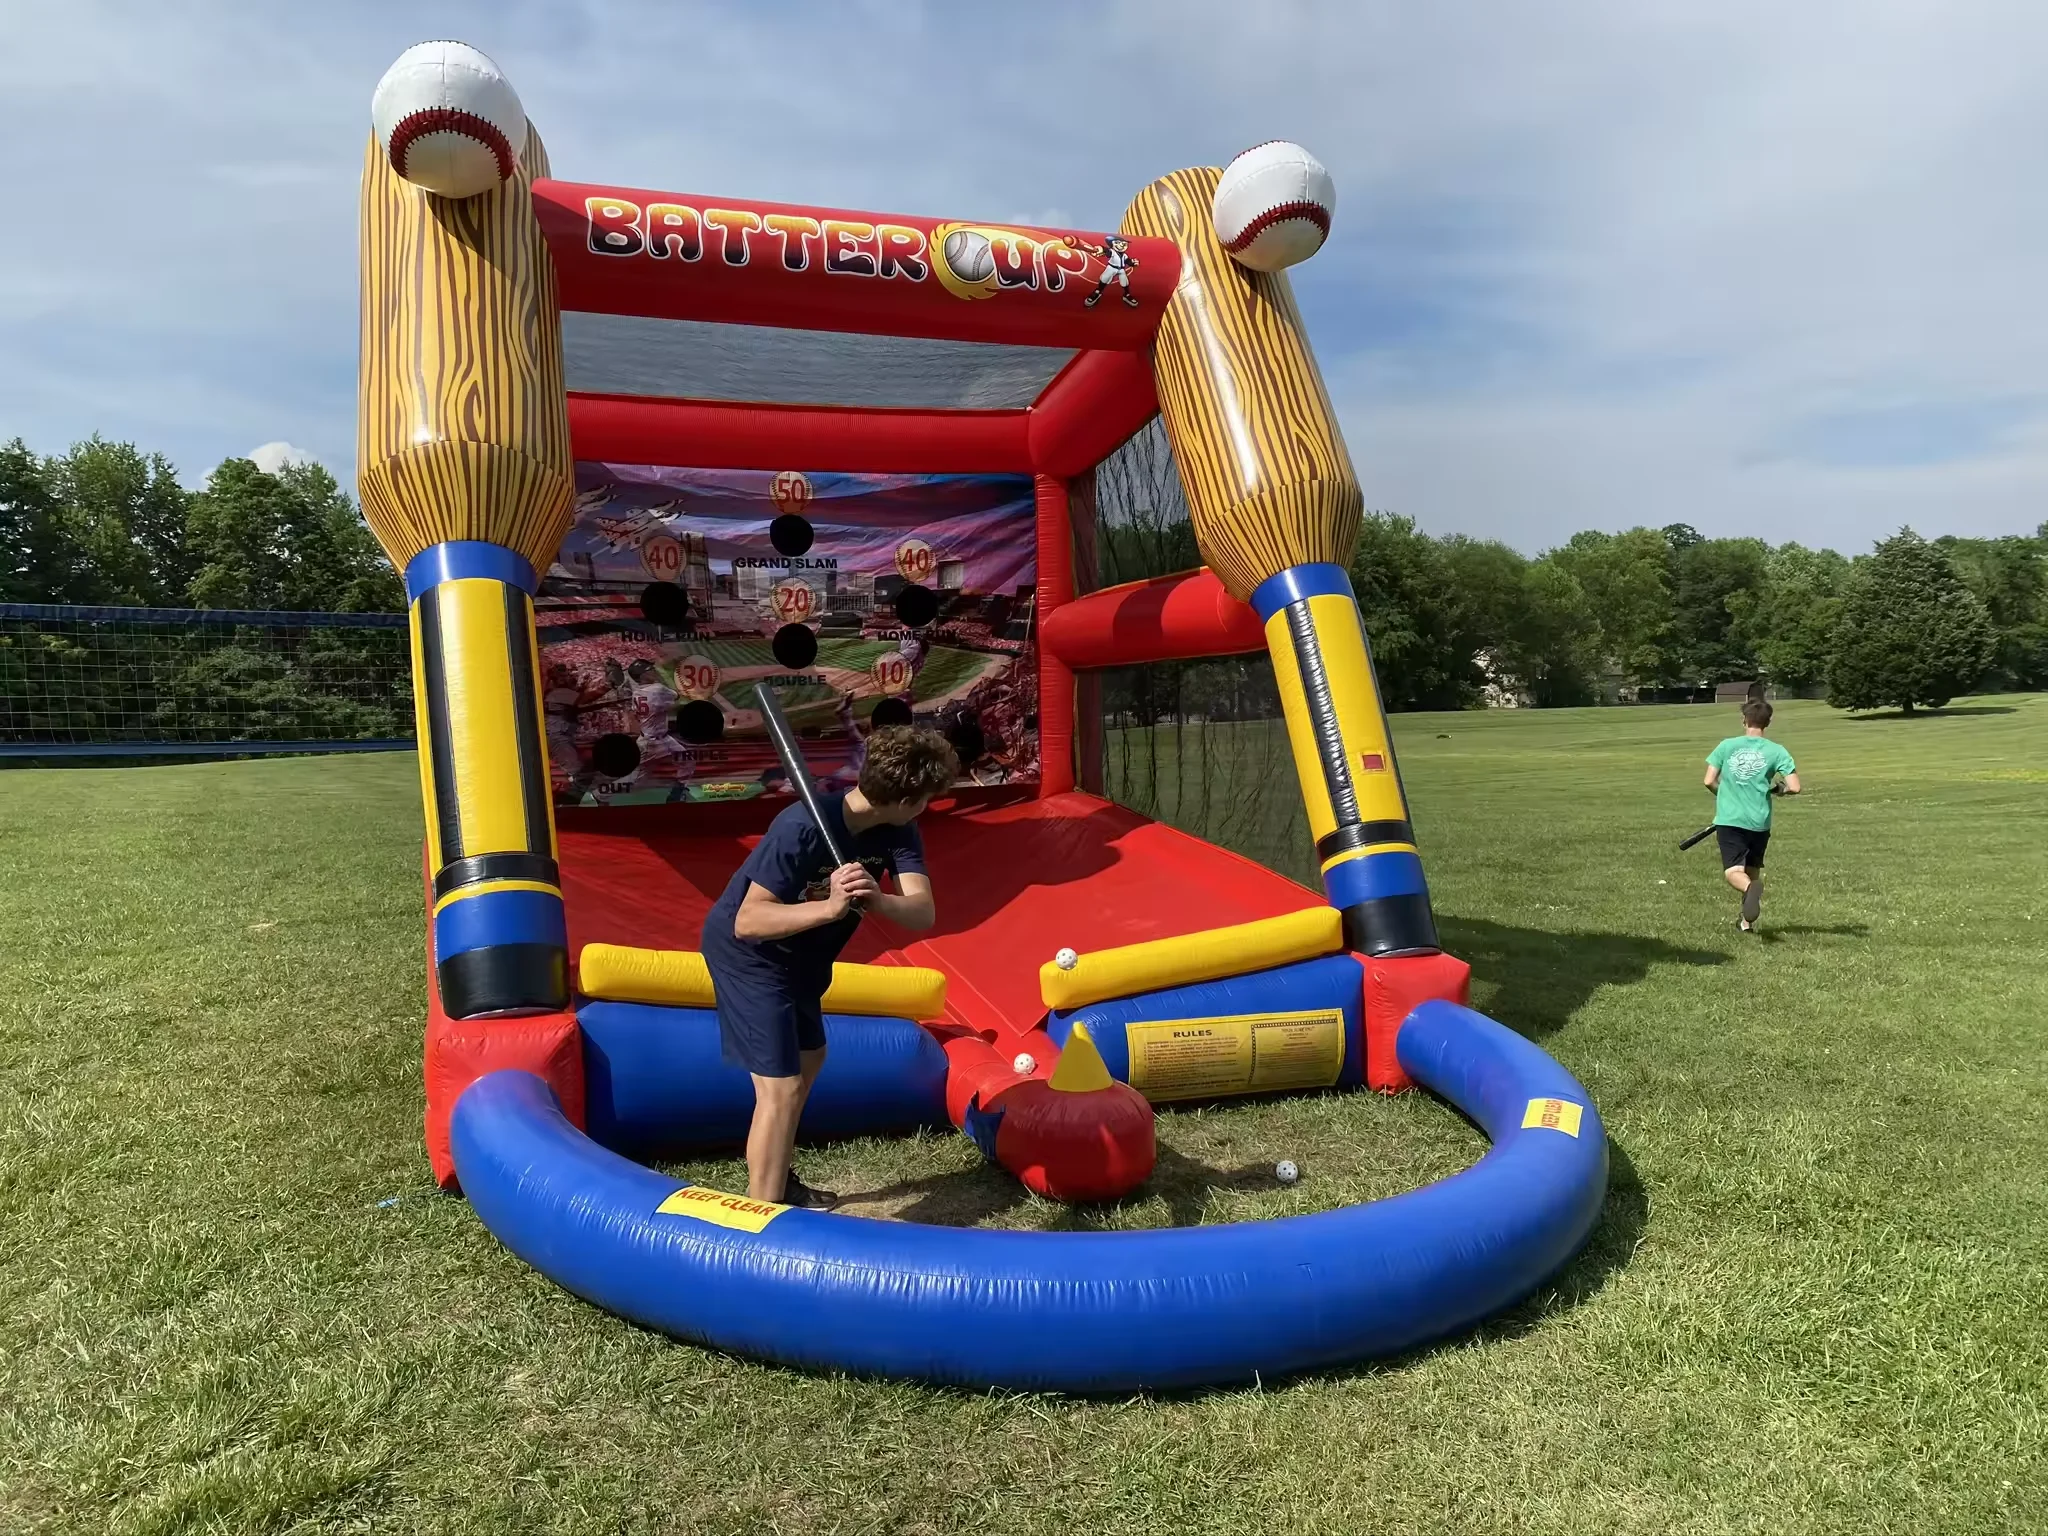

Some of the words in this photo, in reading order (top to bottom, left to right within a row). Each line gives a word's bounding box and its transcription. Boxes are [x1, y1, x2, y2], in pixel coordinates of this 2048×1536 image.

[585, 197, 928, 281] BATTER
[991, 237, 1089, 292] UP
[777, 479, 804, 500] 50
[649, 545, 679, 570] 40
[735, 557, 791, 569] GRAND
[796, 558, 838, 569] SLAM
[903, 548, 929, 573] 40
[779, 587, 809, 612] 20
[677, 631, 710, 642] RUN
[878, 630, 921, 641] HOME
[682, 665, 713, 690] 30
[763, 674, 827, 686] DOUBLE
[879, 661, 904, 685] 10
[672, 750, 729, 761] TRIPLE
[599, 782, 633, 794] OUT
[1173, 1029, 1213, 1039] RULES
[1540, 1113, 1560, 1128] KEEP
[676, 1189, 722, 1203] KEEP
[720, 1198, 776, 1217] CLEAR
